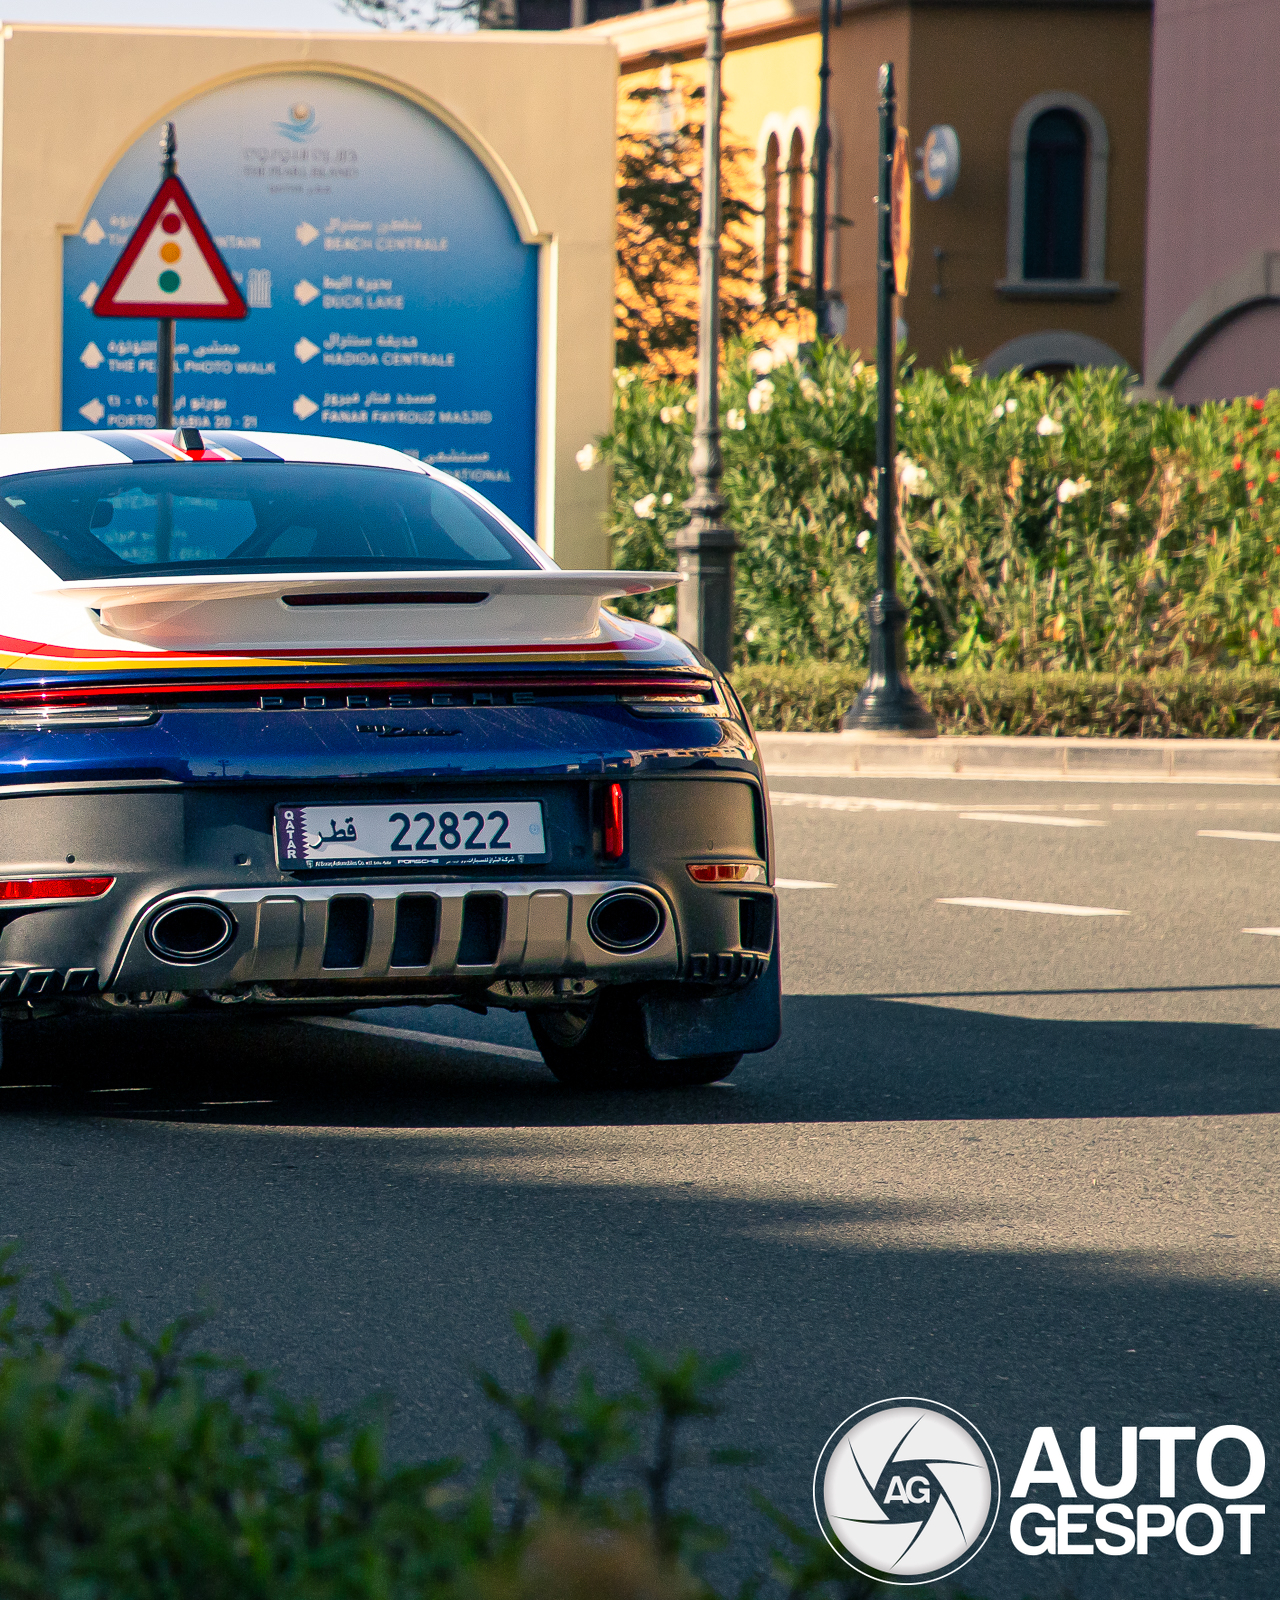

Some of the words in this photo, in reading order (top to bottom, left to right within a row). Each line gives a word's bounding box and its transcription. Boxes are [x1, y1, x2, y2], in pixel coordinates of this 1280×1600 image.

[324, 237, 372, 250] BEACH
[375, 237, 448, 251] CENTRALE
[322, 295, 364, 309] DUCK
[366, 295, 405, 310] LAKE
[108, 359, 135, 373] THE
[138, 359, 182, 374] PEL
[184, 360, 233, 374] PHOTO
[235, 361, 276, 376] WALK
[381, 352, 455, 367] CENTRALE
[107, 414, 157, 428] PORTO
[171, 414, 211, 428] RABIA
[213, 415, 232, 429] 20
[242, 415, 258, 429] 21
[321, 409, 368, 423] FANAR
[371, 410, 436, 424] FAYROUZ
[438, 410, 493, 424] MASJID
[260, 692, 534, 710] PORSCHE
[284, 810, 297, 859] QATAR
[308, 816, 357, 849] قطر
[388, 810, 512, 851] 22822
